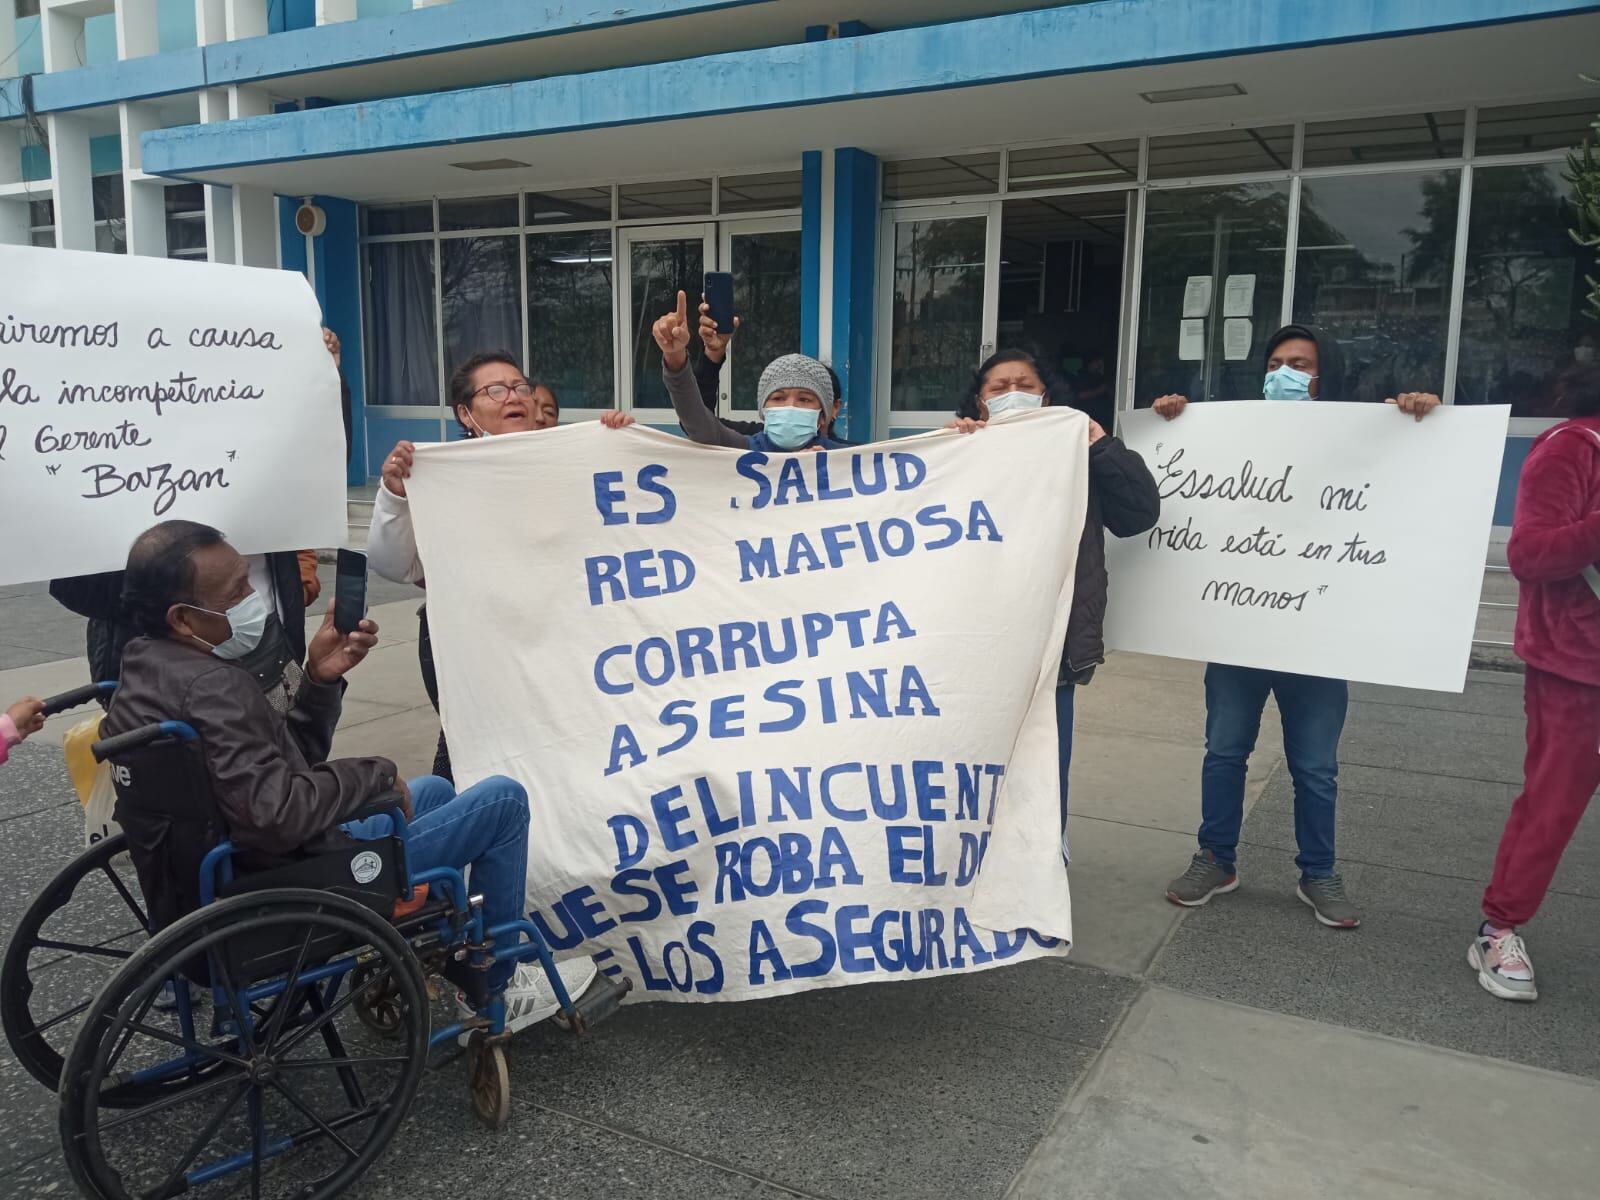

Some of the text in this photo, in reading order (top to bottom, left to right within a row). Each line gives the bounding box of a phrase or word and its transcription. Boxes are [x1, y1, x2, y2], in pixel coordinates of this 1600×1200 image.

[147, 326, 171, 350] a
[188, 327, 283, 350] causa
[0, 368, 264, 416] la incompetencia
[35, 420, 152, 453] Gerente
[593, 451, 926, 525] ES SALUD
[1320, 483, 1370, 511] mi
[585, 500, 1003, 605] RED MAFIOSA
[1220, 526, 1286, 556] está
[1297, 542, 1332, 560] en
[1337, 532, 1386, 565] tus
[594, 601, 916, 695] CORRUPTA
[604, 665, 941, 776] ASESINA
[714, 827, 864, 904] ROBA
[885, 825, 947, 887] EL
[627, 920, 725, 995] LOS
